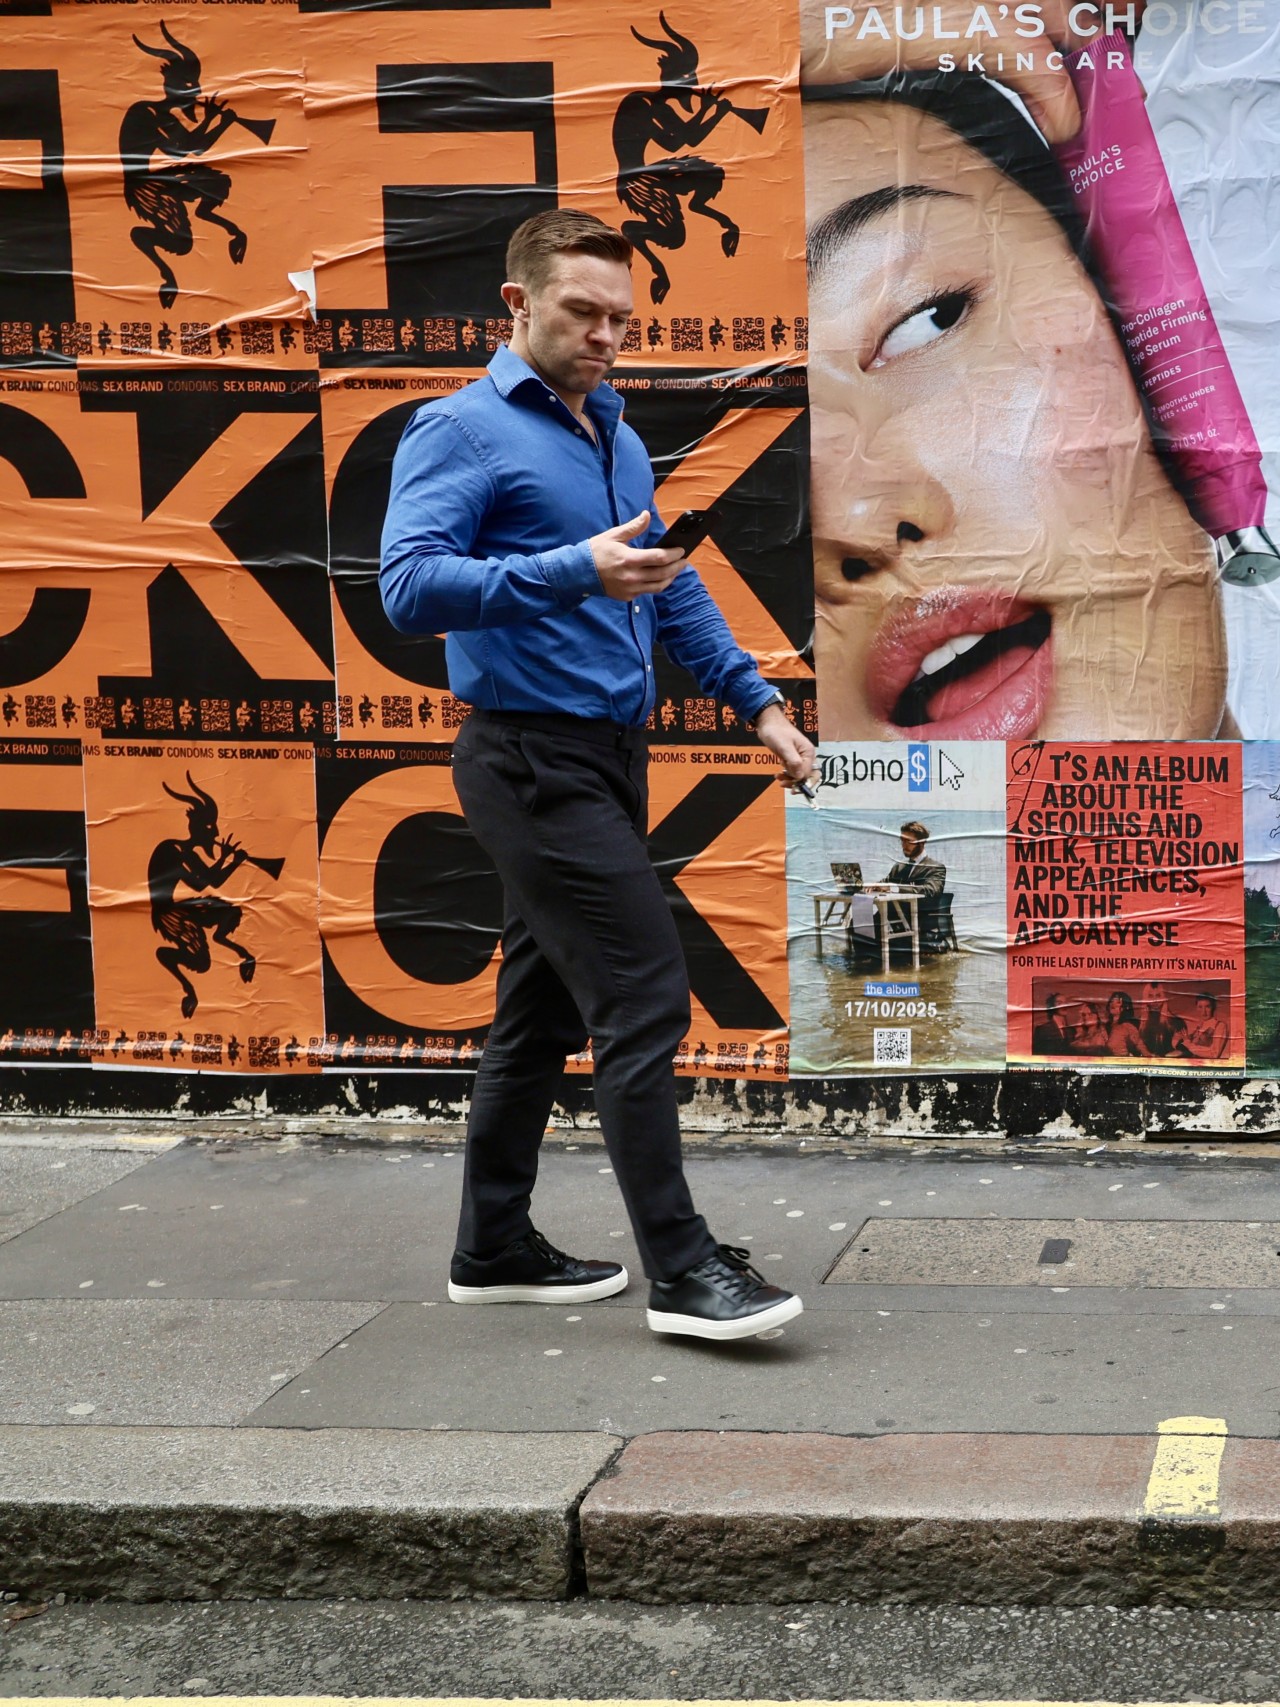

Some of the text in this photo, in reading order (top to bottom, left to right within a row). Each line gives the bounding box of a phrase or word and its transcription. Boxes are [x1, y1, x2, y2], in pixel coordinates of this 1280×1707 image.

[825, 1, 1267, 40] PAULA'S CHOICE
[938, 51, 1156, 73] SKINCARE
[1070, 144, 1121, 181] PAULA'S
[1074, 158, 1125, 194] CHOICE
[1121, 299, 1185, 334] Pro-Collagen
[1126, 309, 1207, 349] Peptide Firming
[1145, 334, 1181, 356] Serum
[102, 381, 124, 392] SEX
[126, 381, 163, 392] BRAND
[168, 381, 219, 392] CONDOMS
[344, 379, 366, 390] SEX
[410, 379, 462, 390] CONDOMS
[612, 378, 731, 390] BRAND CONDOMS SEX
[1144, 365, 1182, 388] PEPTIDES
[104, 746, 124, 757] SEX
[167, 747, 214, 759] CONDOMS
[336, 749, 450, 761] SEX BRAND CONDOMS
[1093, 756, 1128, 782] AN
[1135, 756, 1228, 782] ALBUM
[1041, 783, 1183, 810] ABOUT THE
[1147, 813, 1202, 838] AND
[1015, 838, 1238, 868] MILK, TELEVISION
[1014, 866, 1206, 897] APPEARENCES,
[1014, 893, 1122, 919] AND THE
[1014, 921, 1179, 946] APOCALYPSE
[1012, 956, 1237, 970] FOR THE LAST DINNER PARTY IT'S NATURAL
[866, 984, 918, 995] the album
[844, 1001, 937, 1018] 17/10/2025
[1158, 1069, 1187, 1077] SECOND
